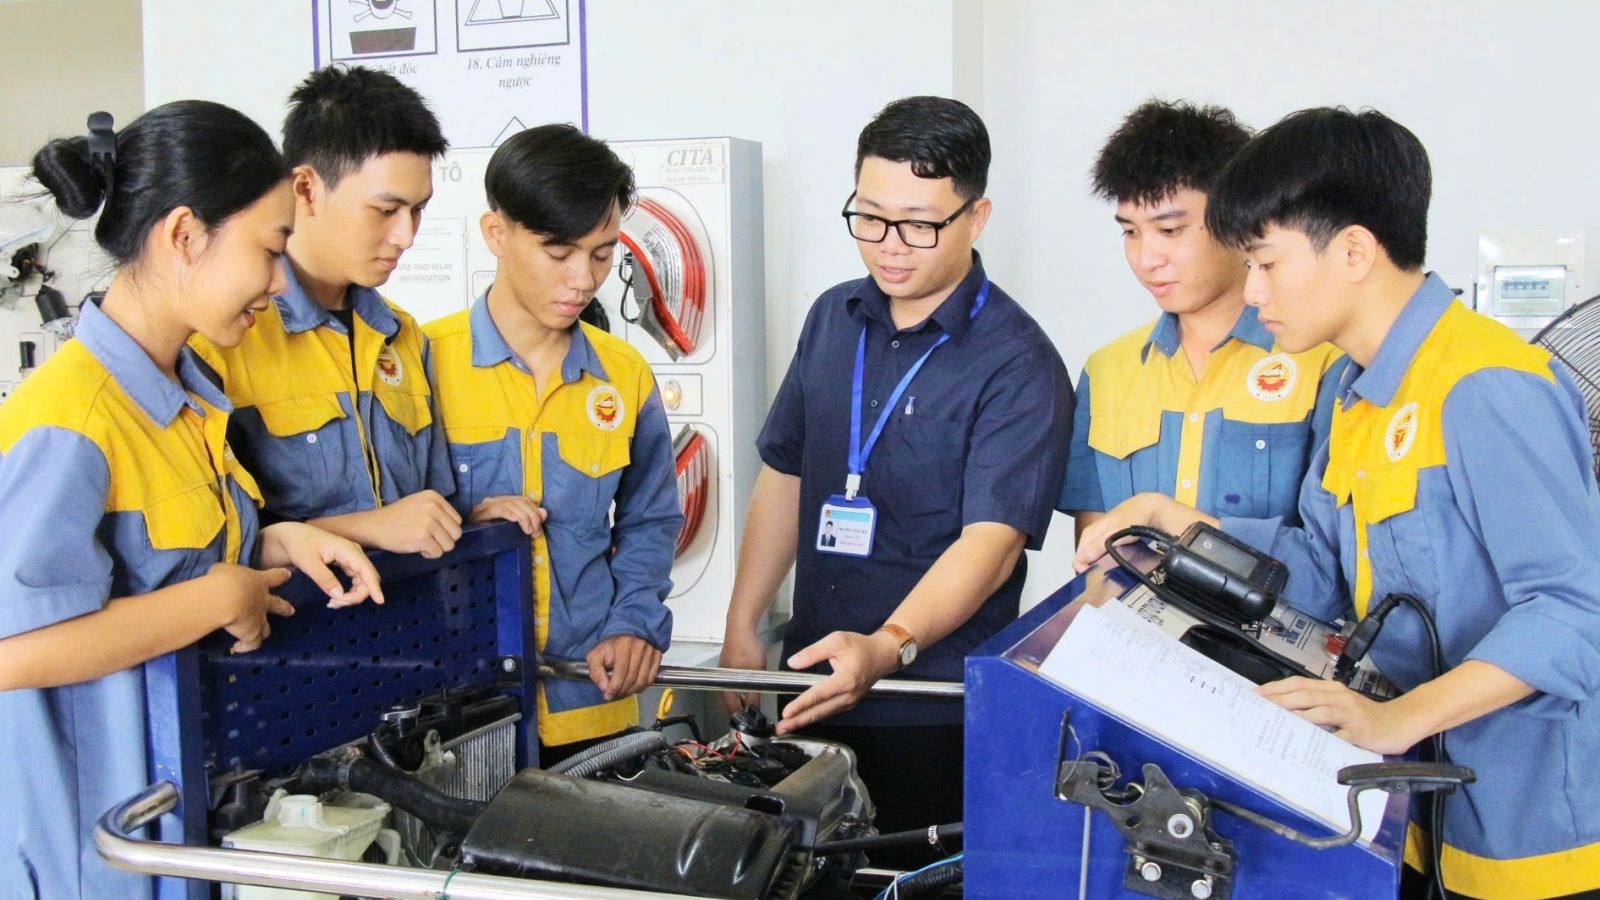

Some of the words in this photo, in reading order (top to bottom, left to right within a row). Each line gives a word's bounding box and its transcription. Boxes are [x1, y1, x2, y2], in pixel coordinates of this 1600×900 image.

[467, 58, 482, 70] 18.
[516, 53, 561, 69] nghiêng
[399, 62, 418, 76] độc
[498, 77, 533, 90] ngược
[667, 148, 713, 166] CITA
[439, 161, 462, 182] TÔ
[413, 263, 430, 271] AND
[431, 263, 453, 271] RELAY
[399, 273, 451, 282] INFORMATION
